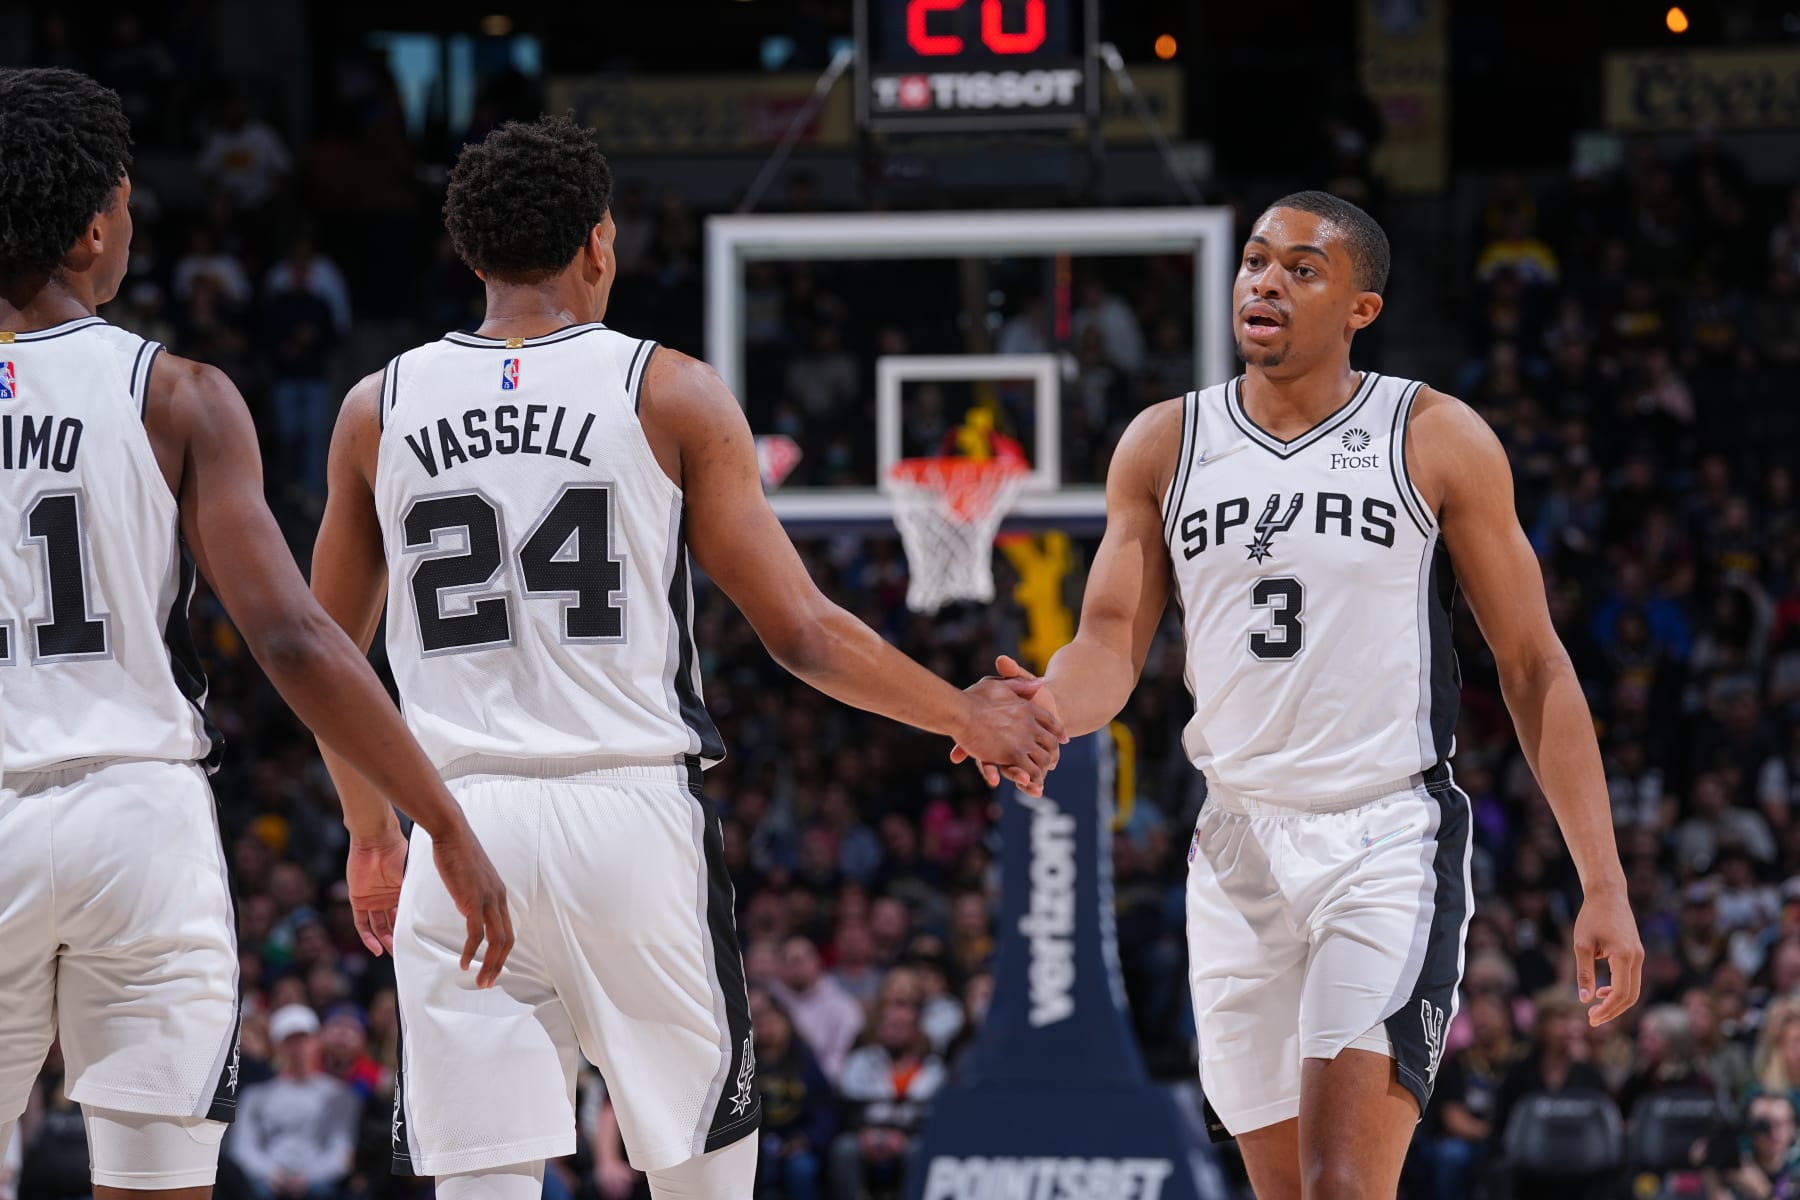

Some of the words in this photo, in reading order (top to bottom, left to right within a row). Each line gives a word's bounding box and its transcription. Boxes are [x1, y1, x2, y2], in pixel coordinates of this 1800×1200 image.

[929, 70, 1083, 108] TISSOT
[2, 415, 84, 473] IMO
[404, 404, 596, 478] VASSELL
[1330, 453, 1380, 470] Frost
[1180, 491, 1397, 565] SPURS
[0, 487, 113, 667] 1
[400, 481, 627, 659] 24
[1248, 575, 1306, 661] 3
[1017, 814, 1077, 1029] verizon
[923, 1155, 1175, 1200] POINTSBET
